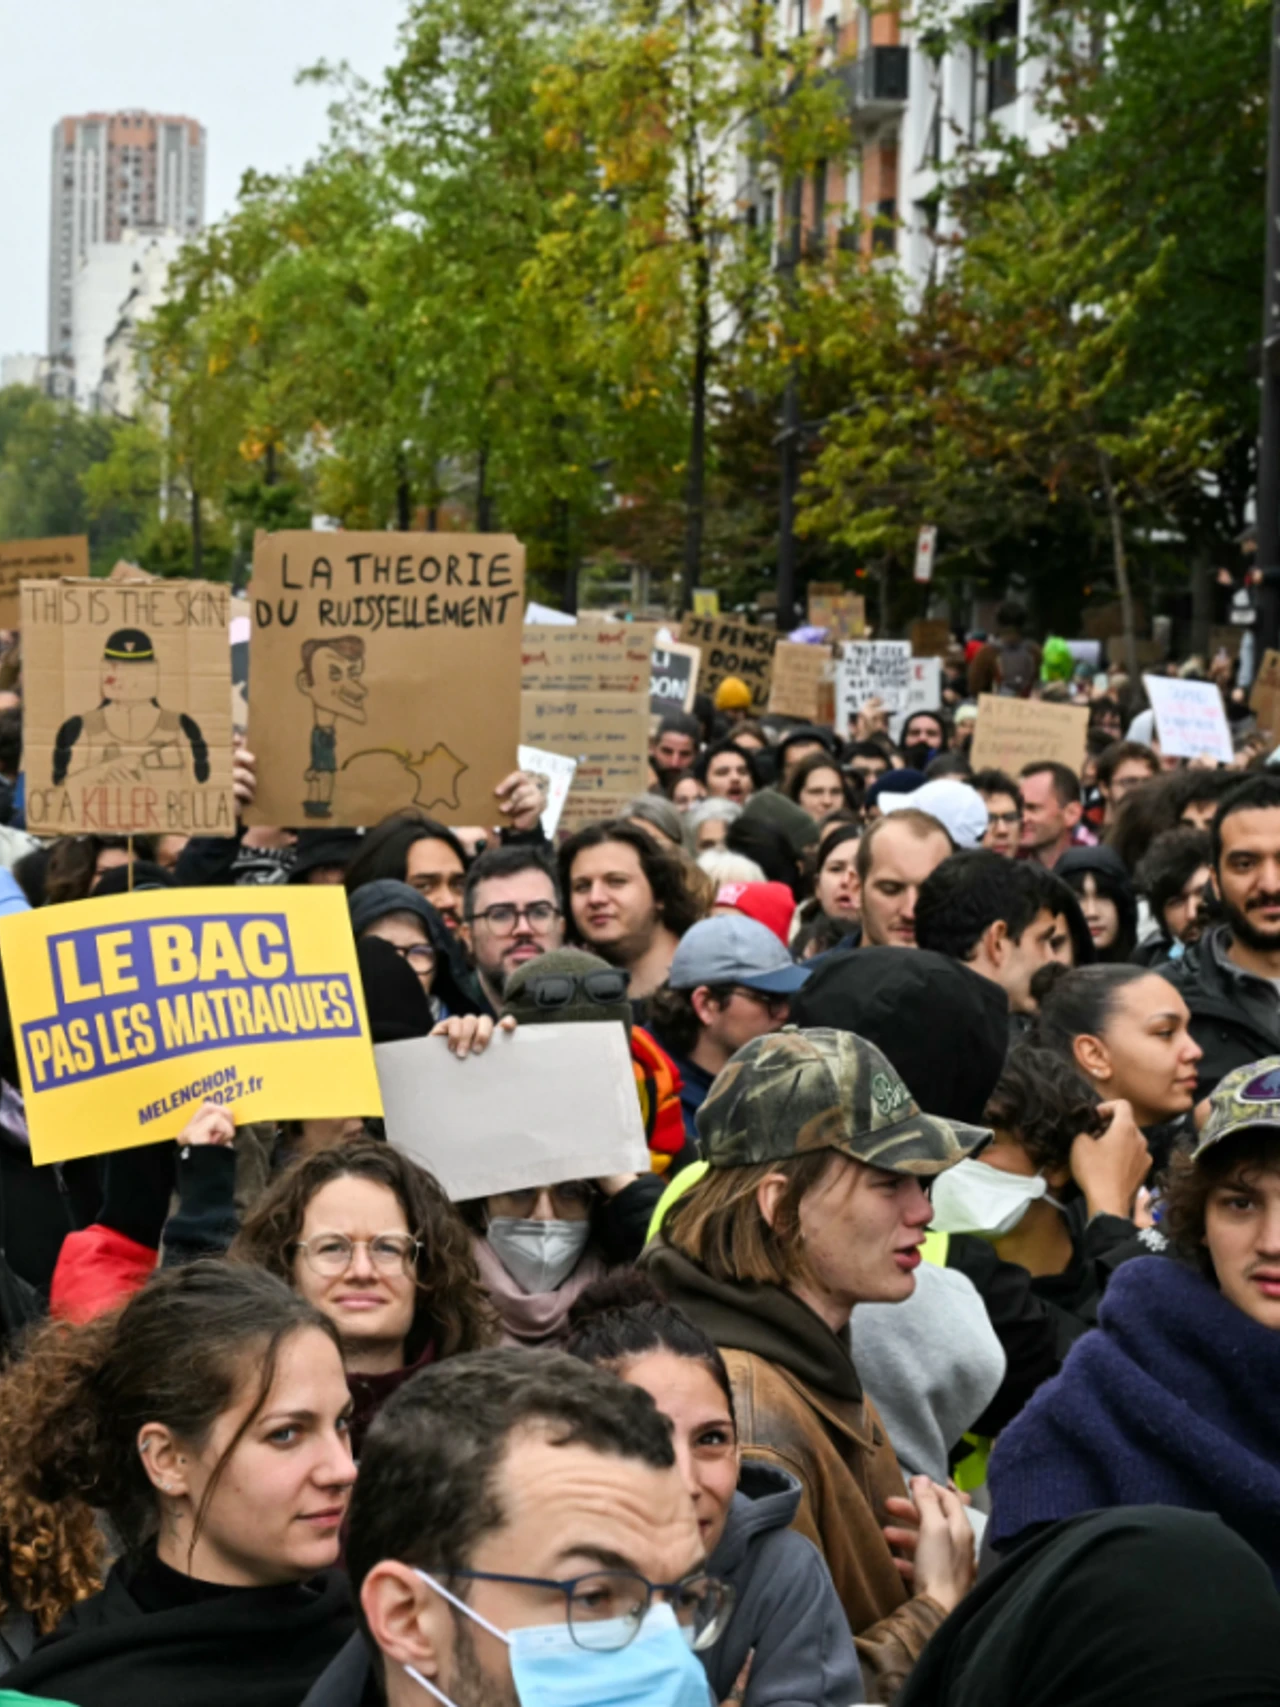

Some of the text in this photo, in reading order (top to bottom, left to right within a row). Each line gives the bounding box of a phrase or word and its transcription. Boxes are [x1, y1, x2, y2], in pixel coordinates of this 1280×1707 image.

[281, 552, 513, 590] LA THEORIE
[24, 587, 226, 628] THIS IS THE SKIN
[256, 598, 299, 629] DU
[688, 618, 714, 642] JE
[27, 786, 230, 830] OF A KILLER BELLA
[55, 920, 287, 1004] LE BAC
[27, 979, 354, 1084] PAS LES MATRAQUES
[138, 1065, 238, 1126] MELENCHON
